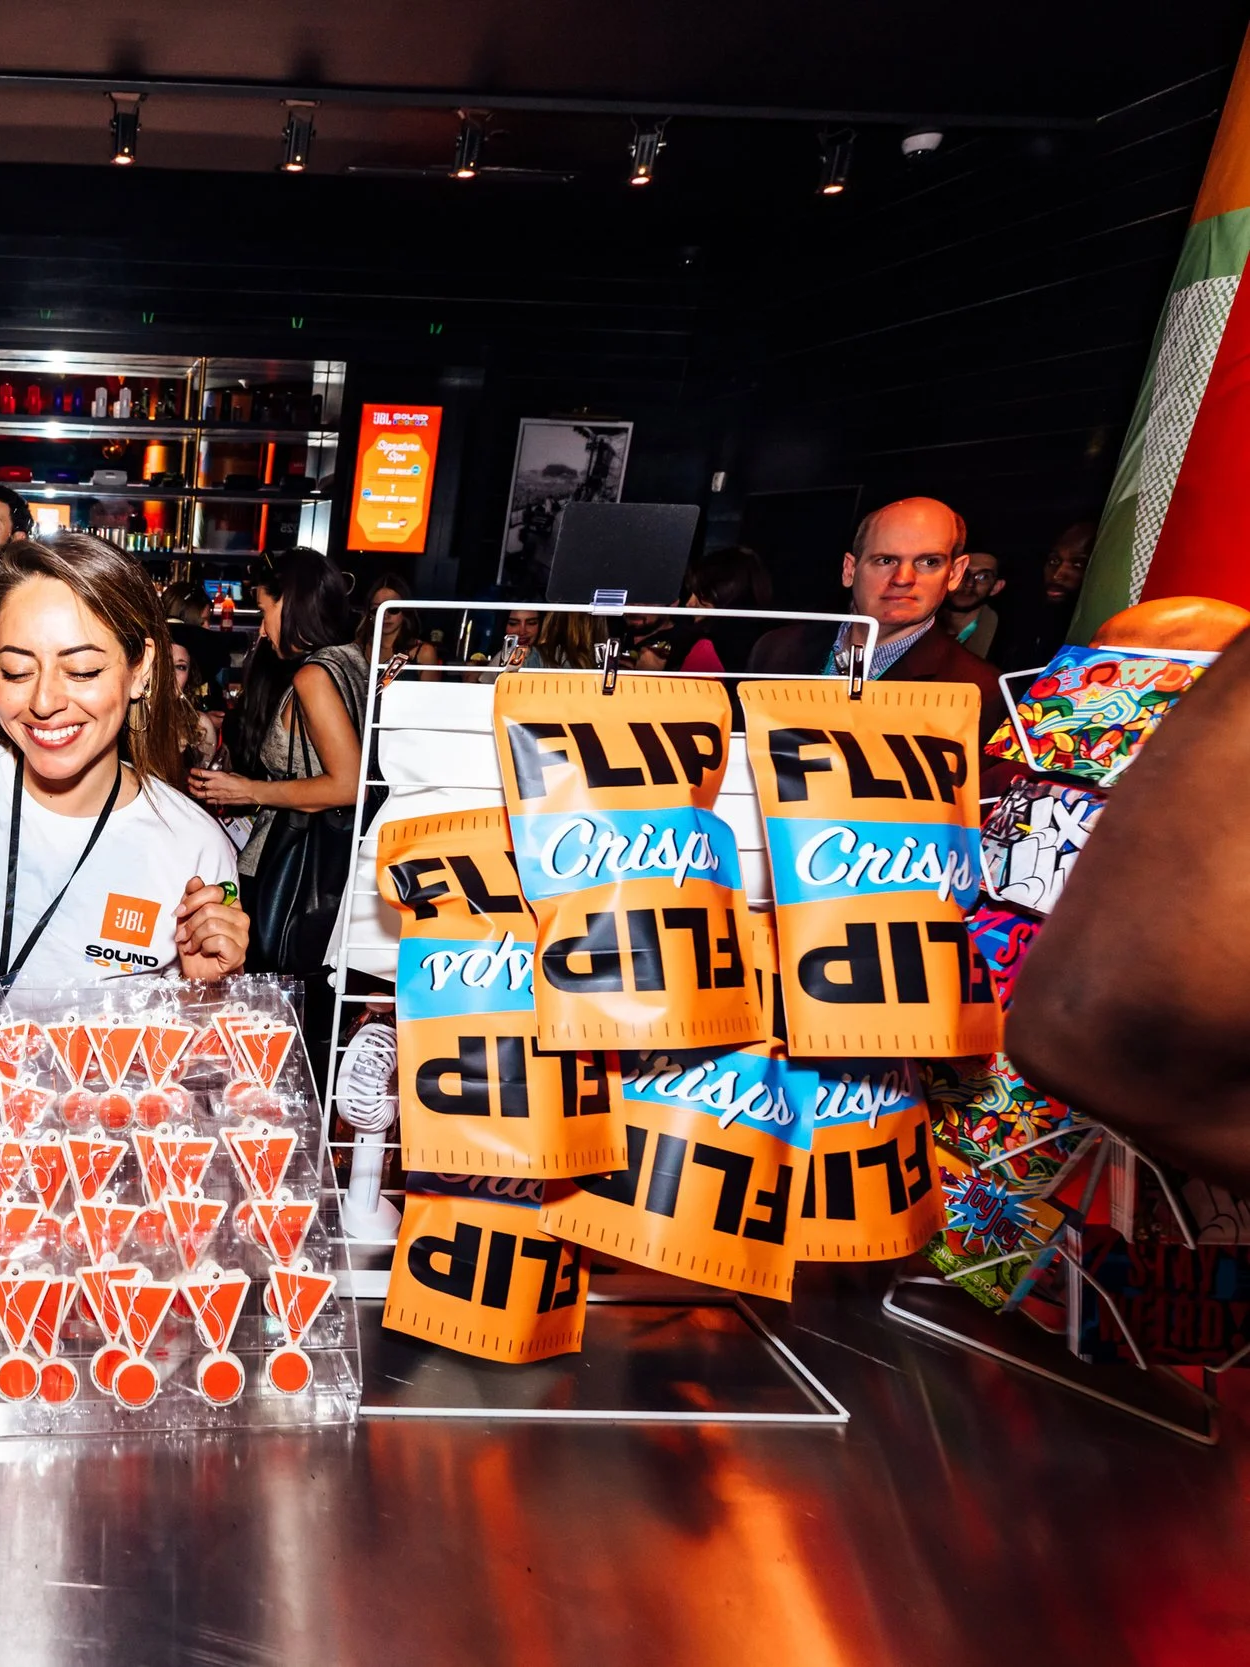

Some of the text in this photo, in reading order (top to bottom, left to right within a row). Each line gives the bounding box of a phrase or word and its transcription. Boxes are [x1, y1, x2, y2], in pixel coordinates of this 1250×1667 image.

[507, 720, 724, 800] FLIP
[768, 726, 968, 805] FLIP
[114, 907, 147, 934] JBL
[541, 907, 746, 994] FLIP
[84, 944, 159, 968] SOUND
[622, 1054, 796, 1130] risps
[959, 1174, 1002, 1221] Toy
[972, 1208, 1026, 1250] Joy
